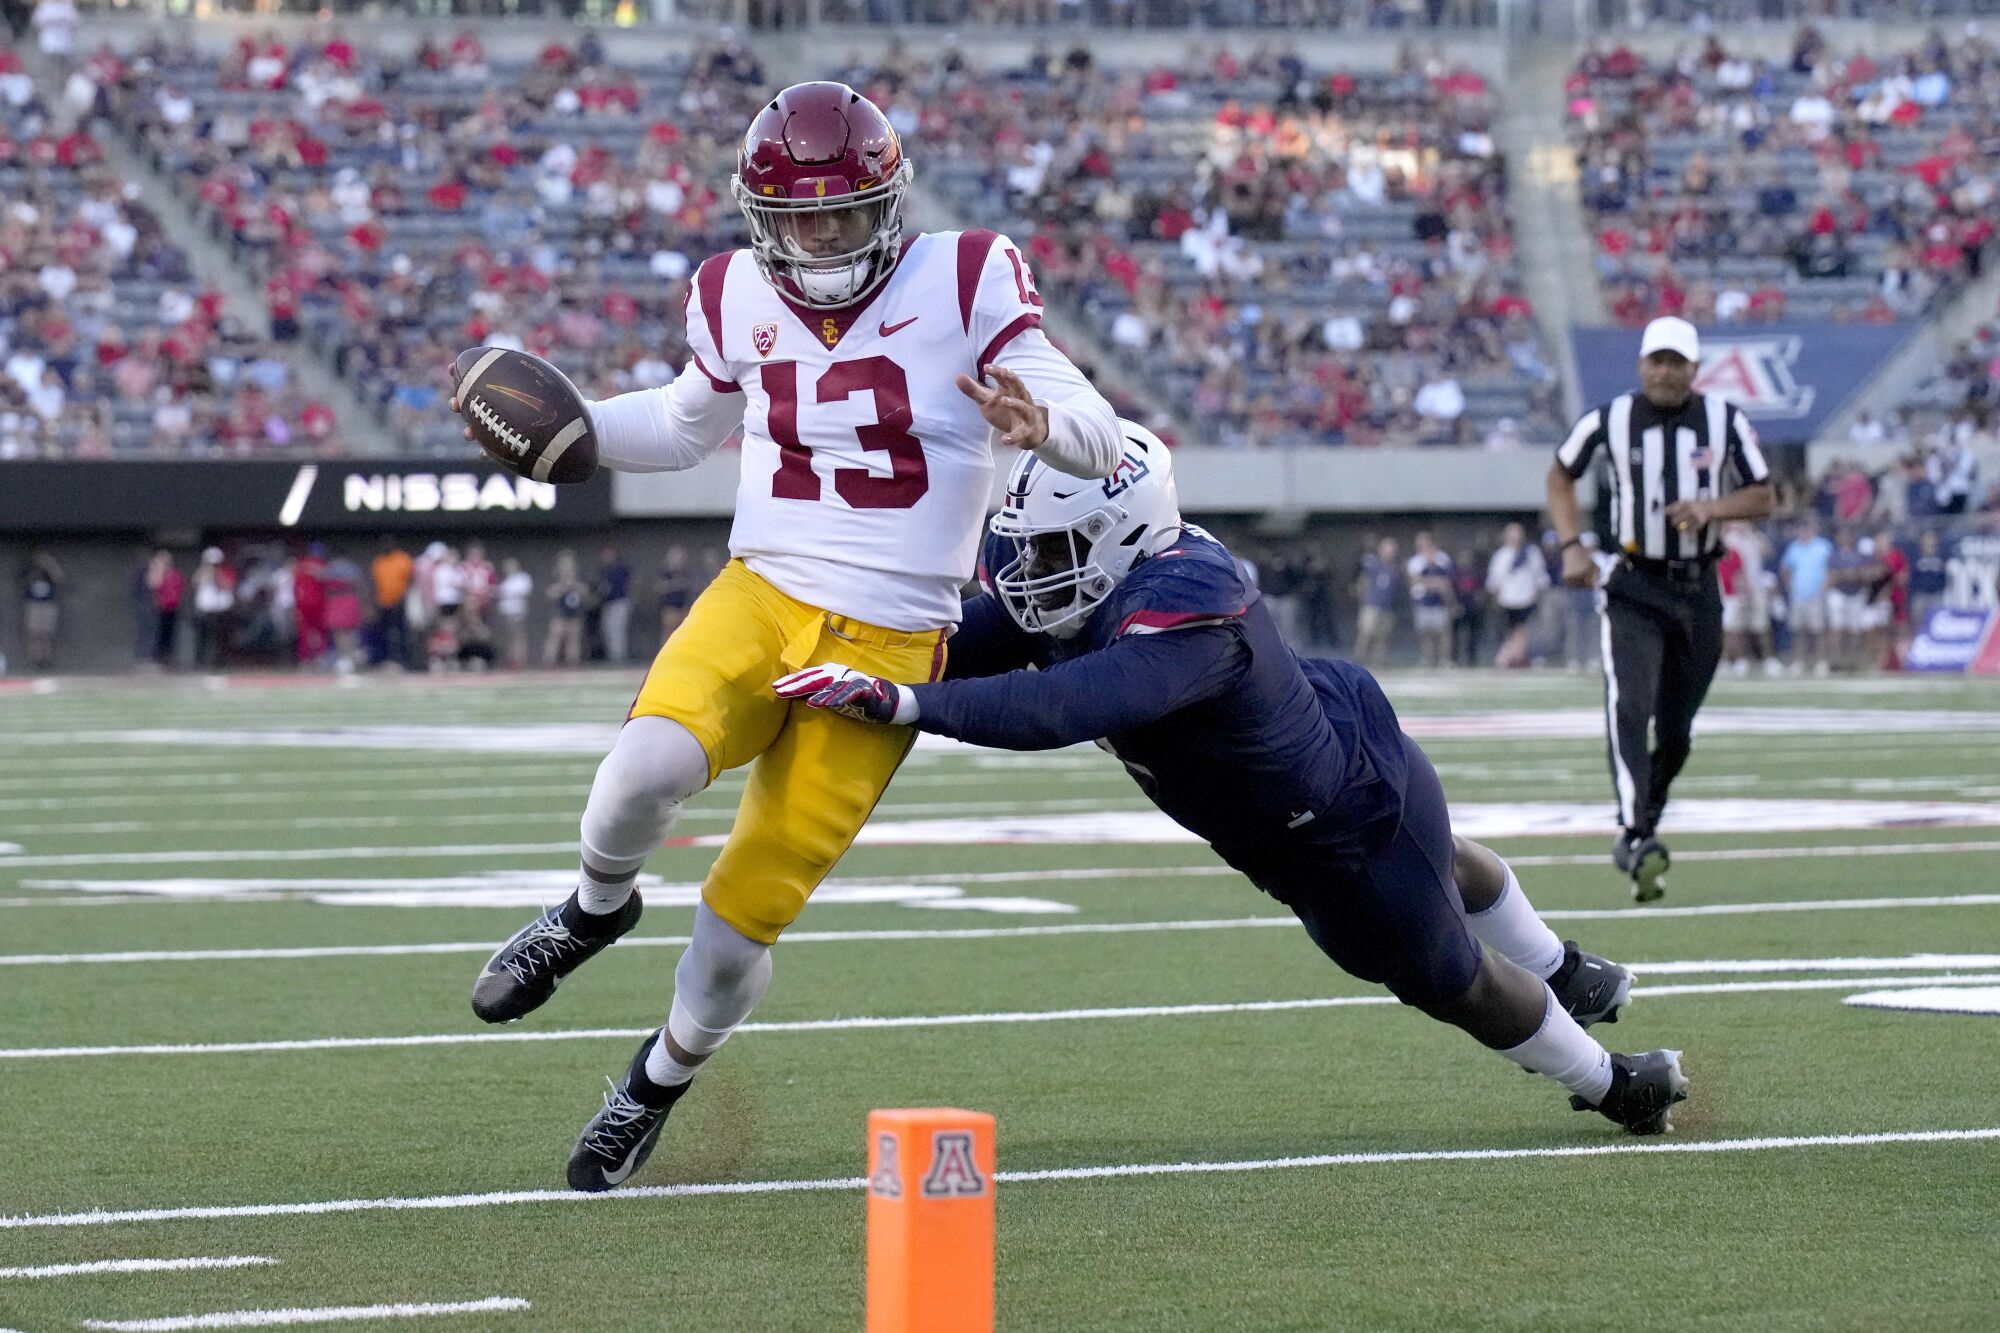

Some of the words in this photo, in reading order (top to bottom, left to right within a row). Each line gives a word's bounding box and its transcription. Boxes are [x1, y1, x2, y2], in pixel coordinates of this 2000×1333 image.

[754, 324, 775, 344] PAC
[760, 355, 929, 509] 13
[344, 473, 556, 511] NISSAN
[924, 1133, 984, 1196] A
